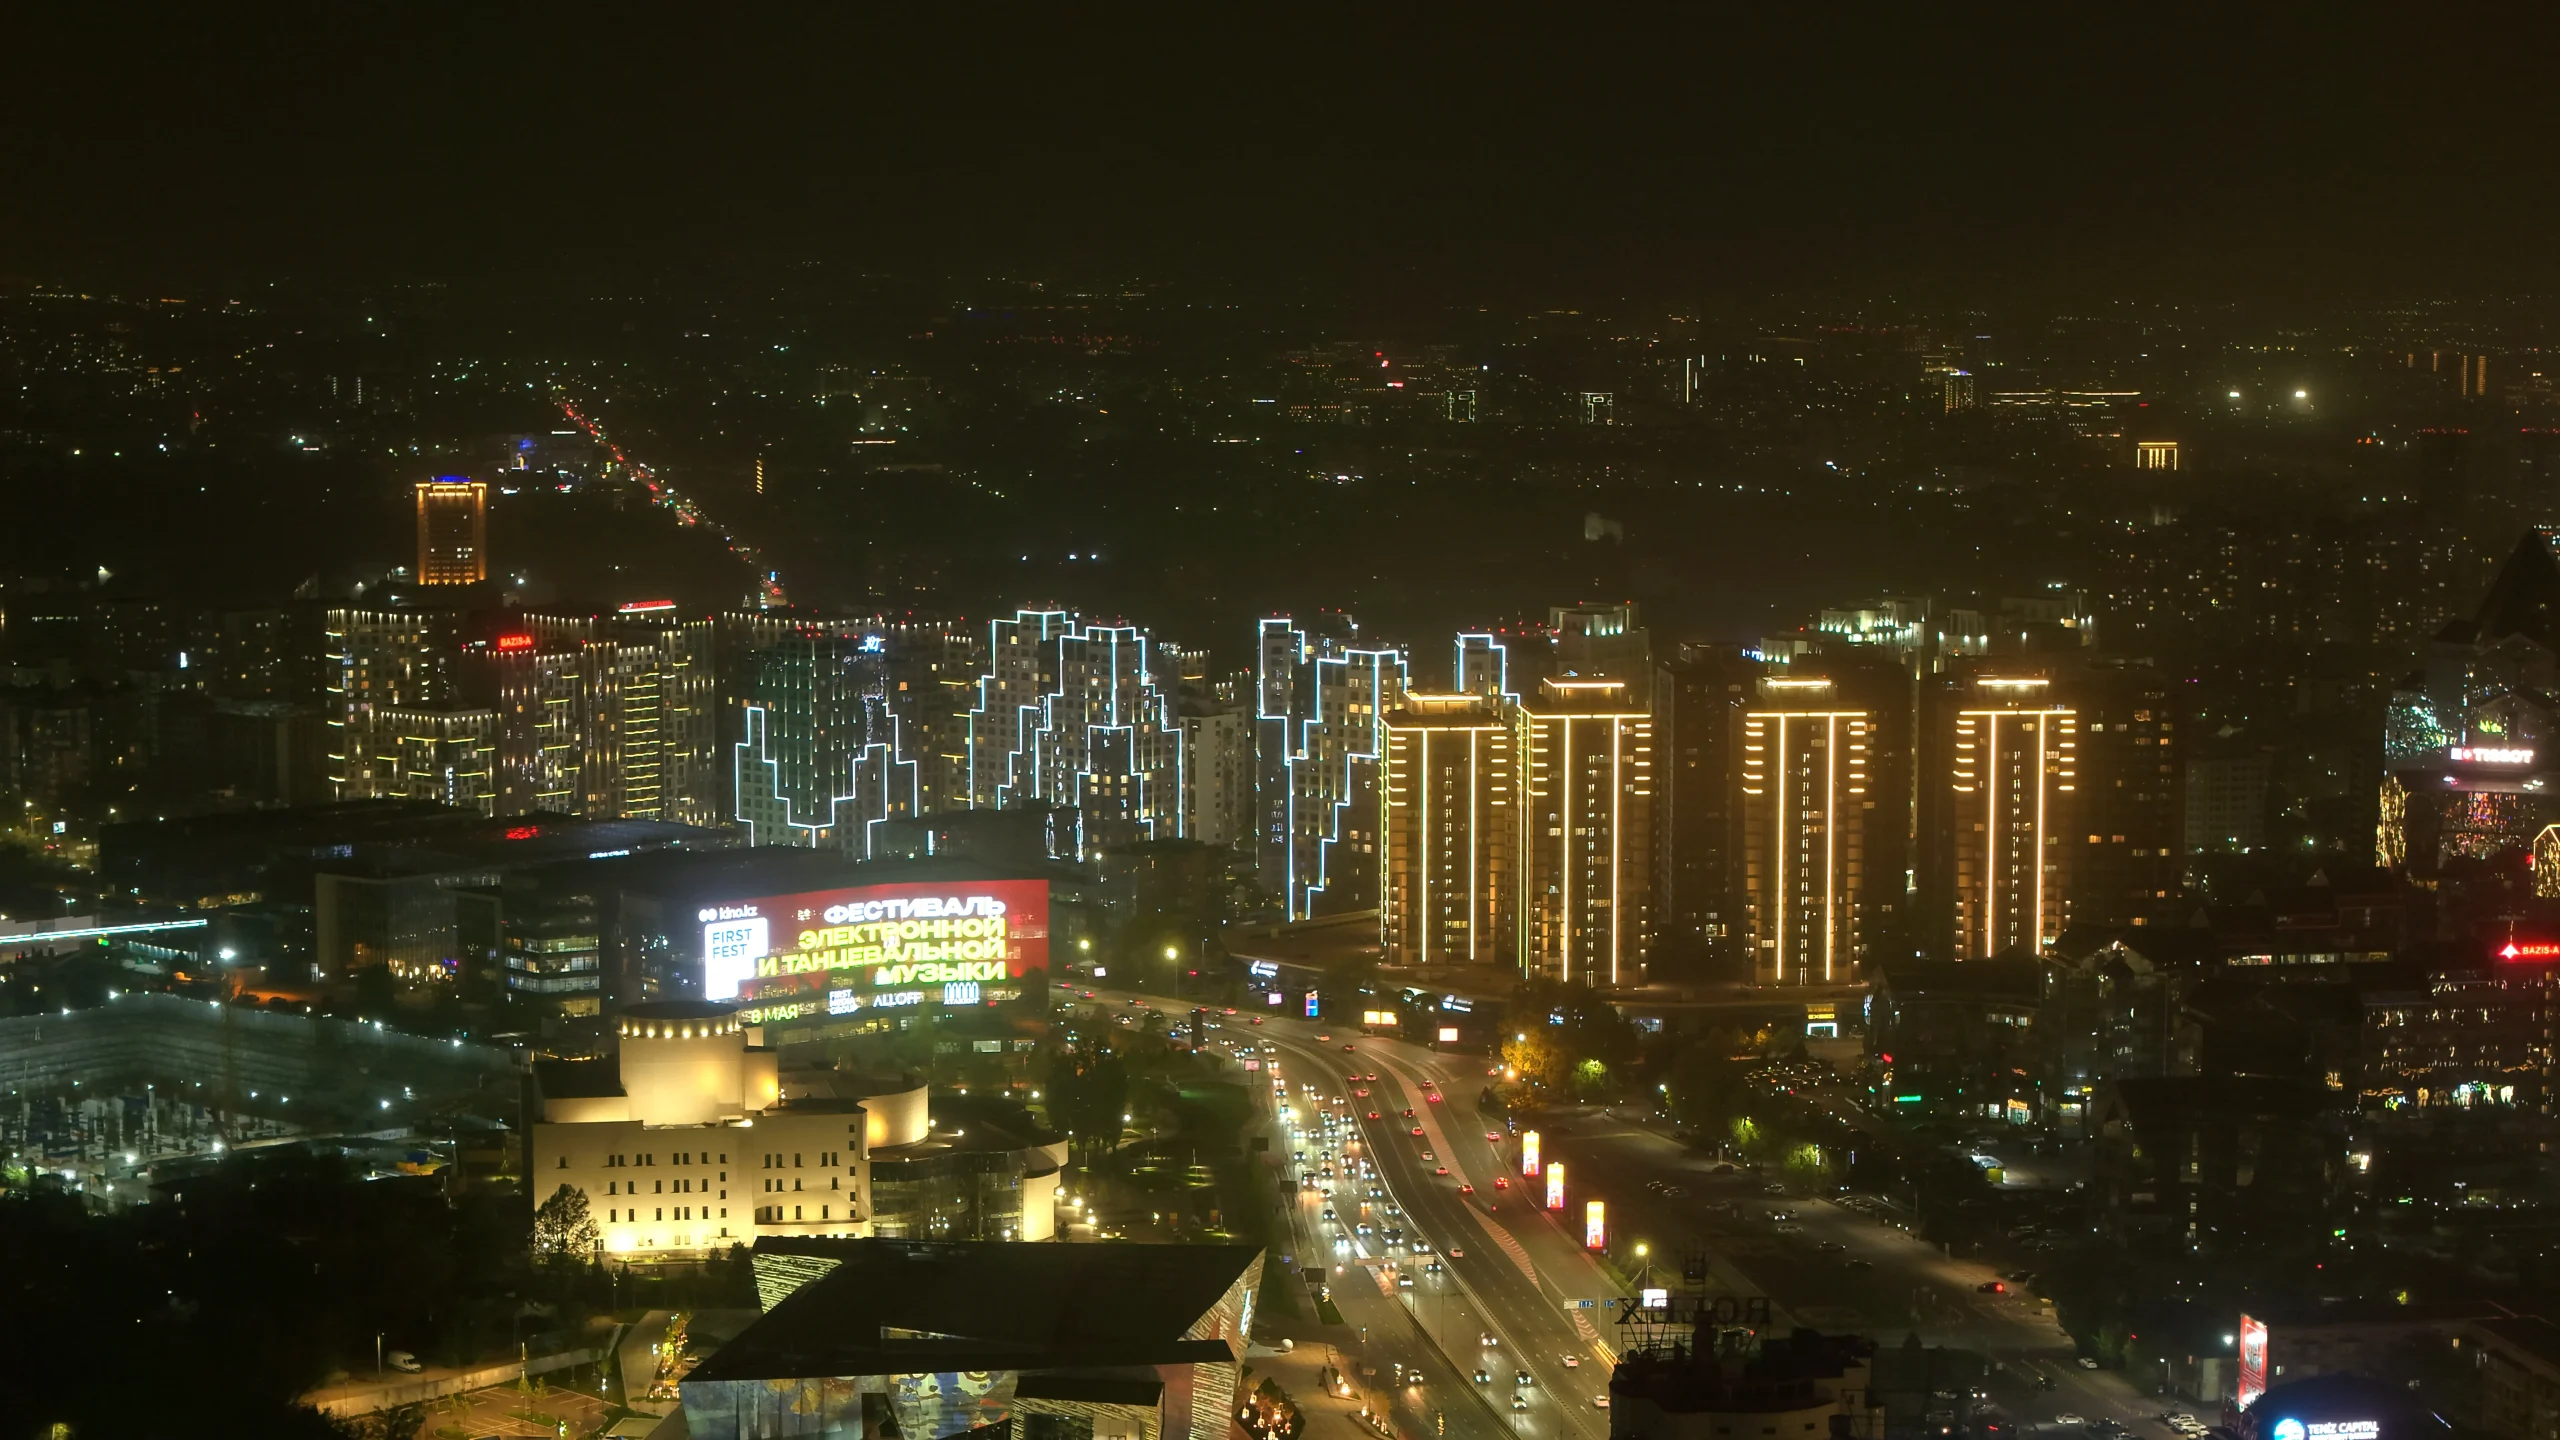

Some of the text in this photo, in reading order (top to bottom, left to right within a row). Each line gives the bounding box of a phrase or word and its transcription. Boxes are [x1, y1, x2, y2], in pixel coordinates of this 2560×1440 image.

[500, 636, 532, 647] BAZIS-A
[2473, 748, 2534, 763] TISSOT
[824, 896, 1006, 924] ФЕСТИВАЛЬ
[712, 928, 752, 944] FIRST
[798, 914, 1006, 950] ЭЛЕКТРОННОЙ
[712, 944, 747, 959] FEST
[758, 936, 1006, 977] И ТАНЦЕВАЛЬНОЙ
[2522, 945, 2560, 955] BAZIS-A
[876, 961, 1006, 985] МУЗЫКИ
[765, 1004, 798, 1022] МАЯ
[2338, 1421, 2379, 1433] CAPITAL
